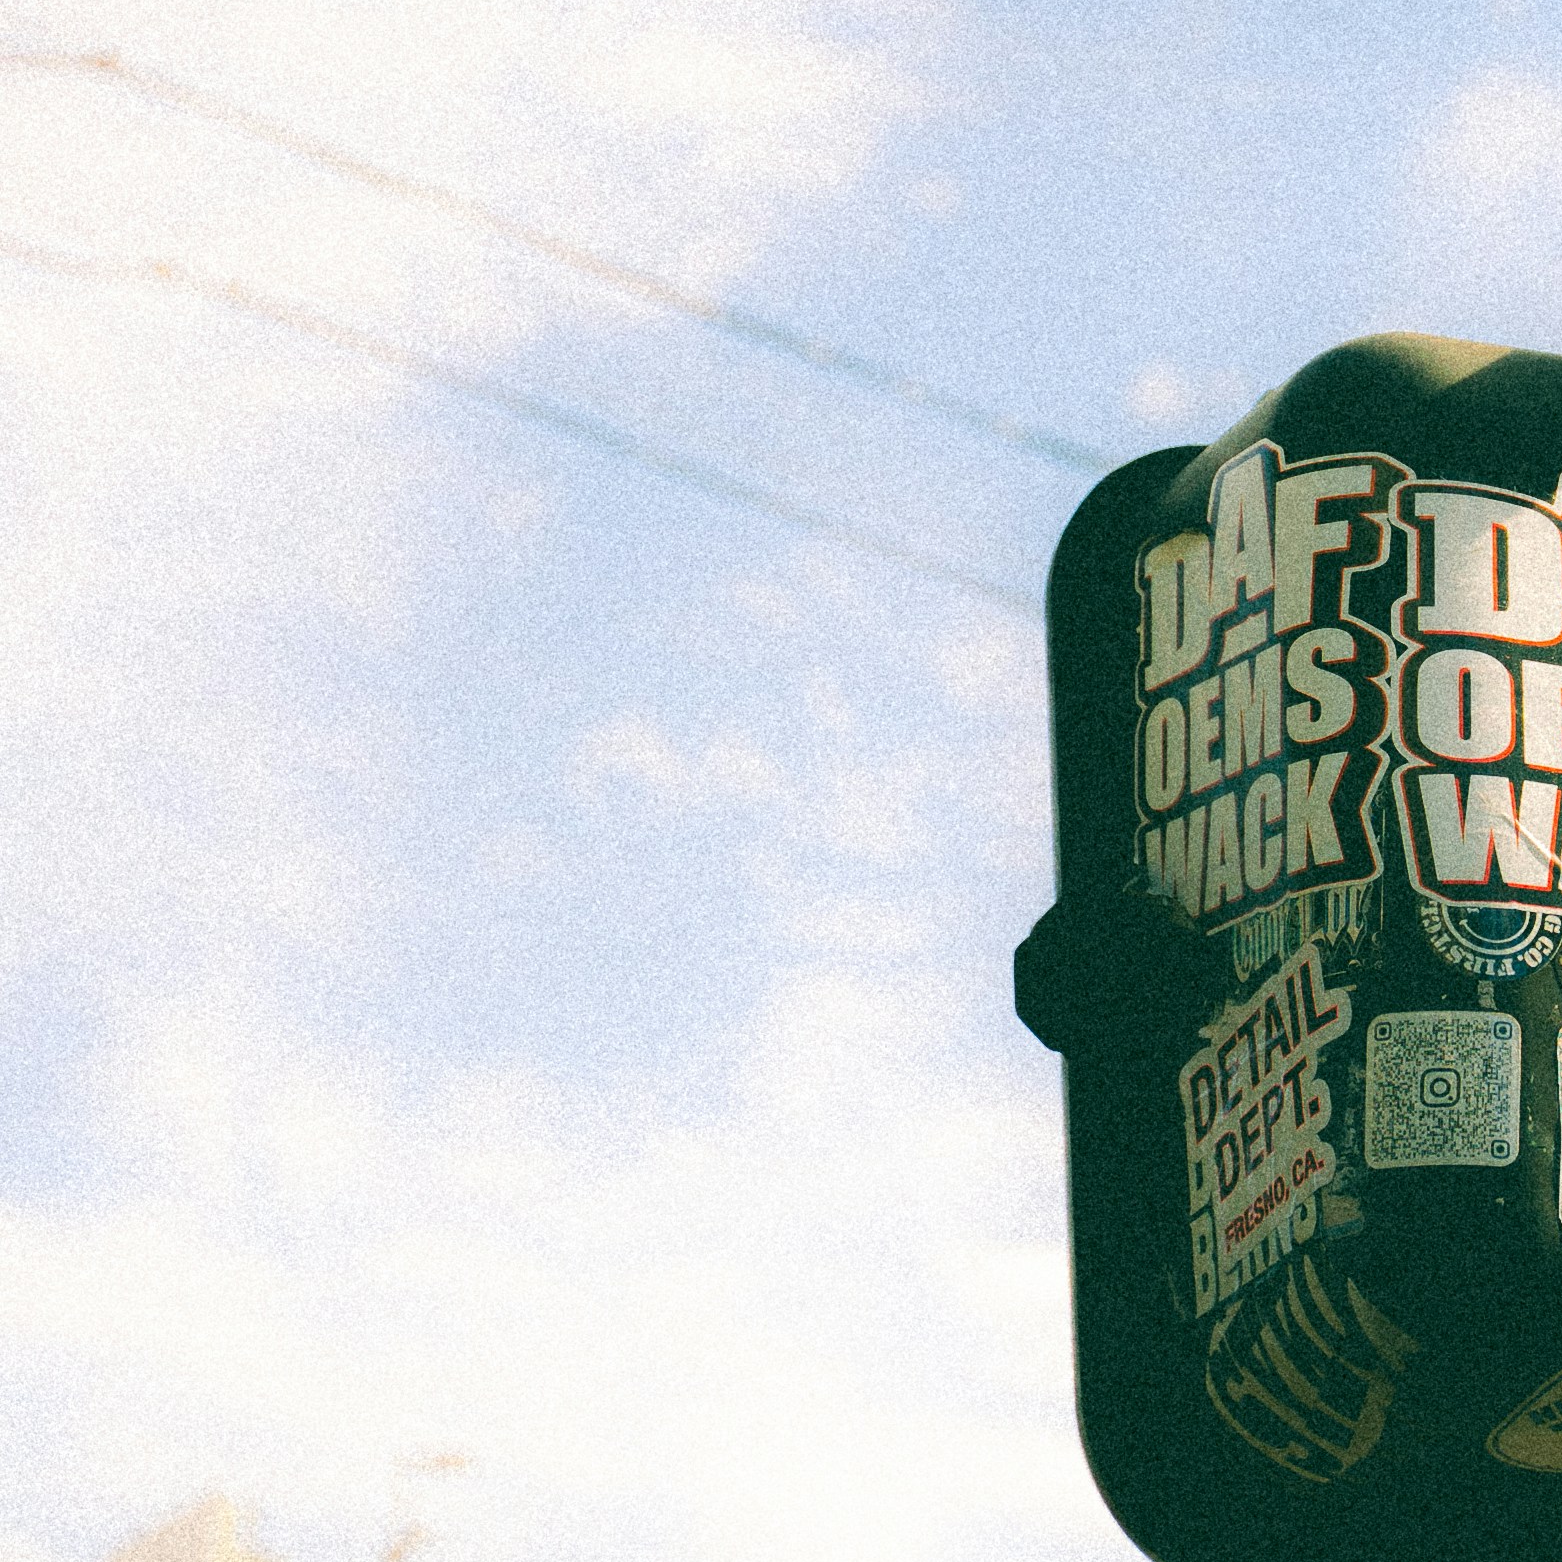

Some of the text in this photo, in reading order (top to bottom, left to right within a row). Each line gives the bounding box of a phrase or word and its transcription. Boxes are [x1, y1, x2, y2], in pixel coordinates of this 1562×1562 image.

[1144, 628, 1356, 812] OEMS
[1146, 751, 1348, 917] WACK
[1189, 960, 1339, 1145] DETAIL
[1215, 1056, 1321, 1202] DEPT.
[1224, 1148, 1325, 1254] FRESNO, CA.
